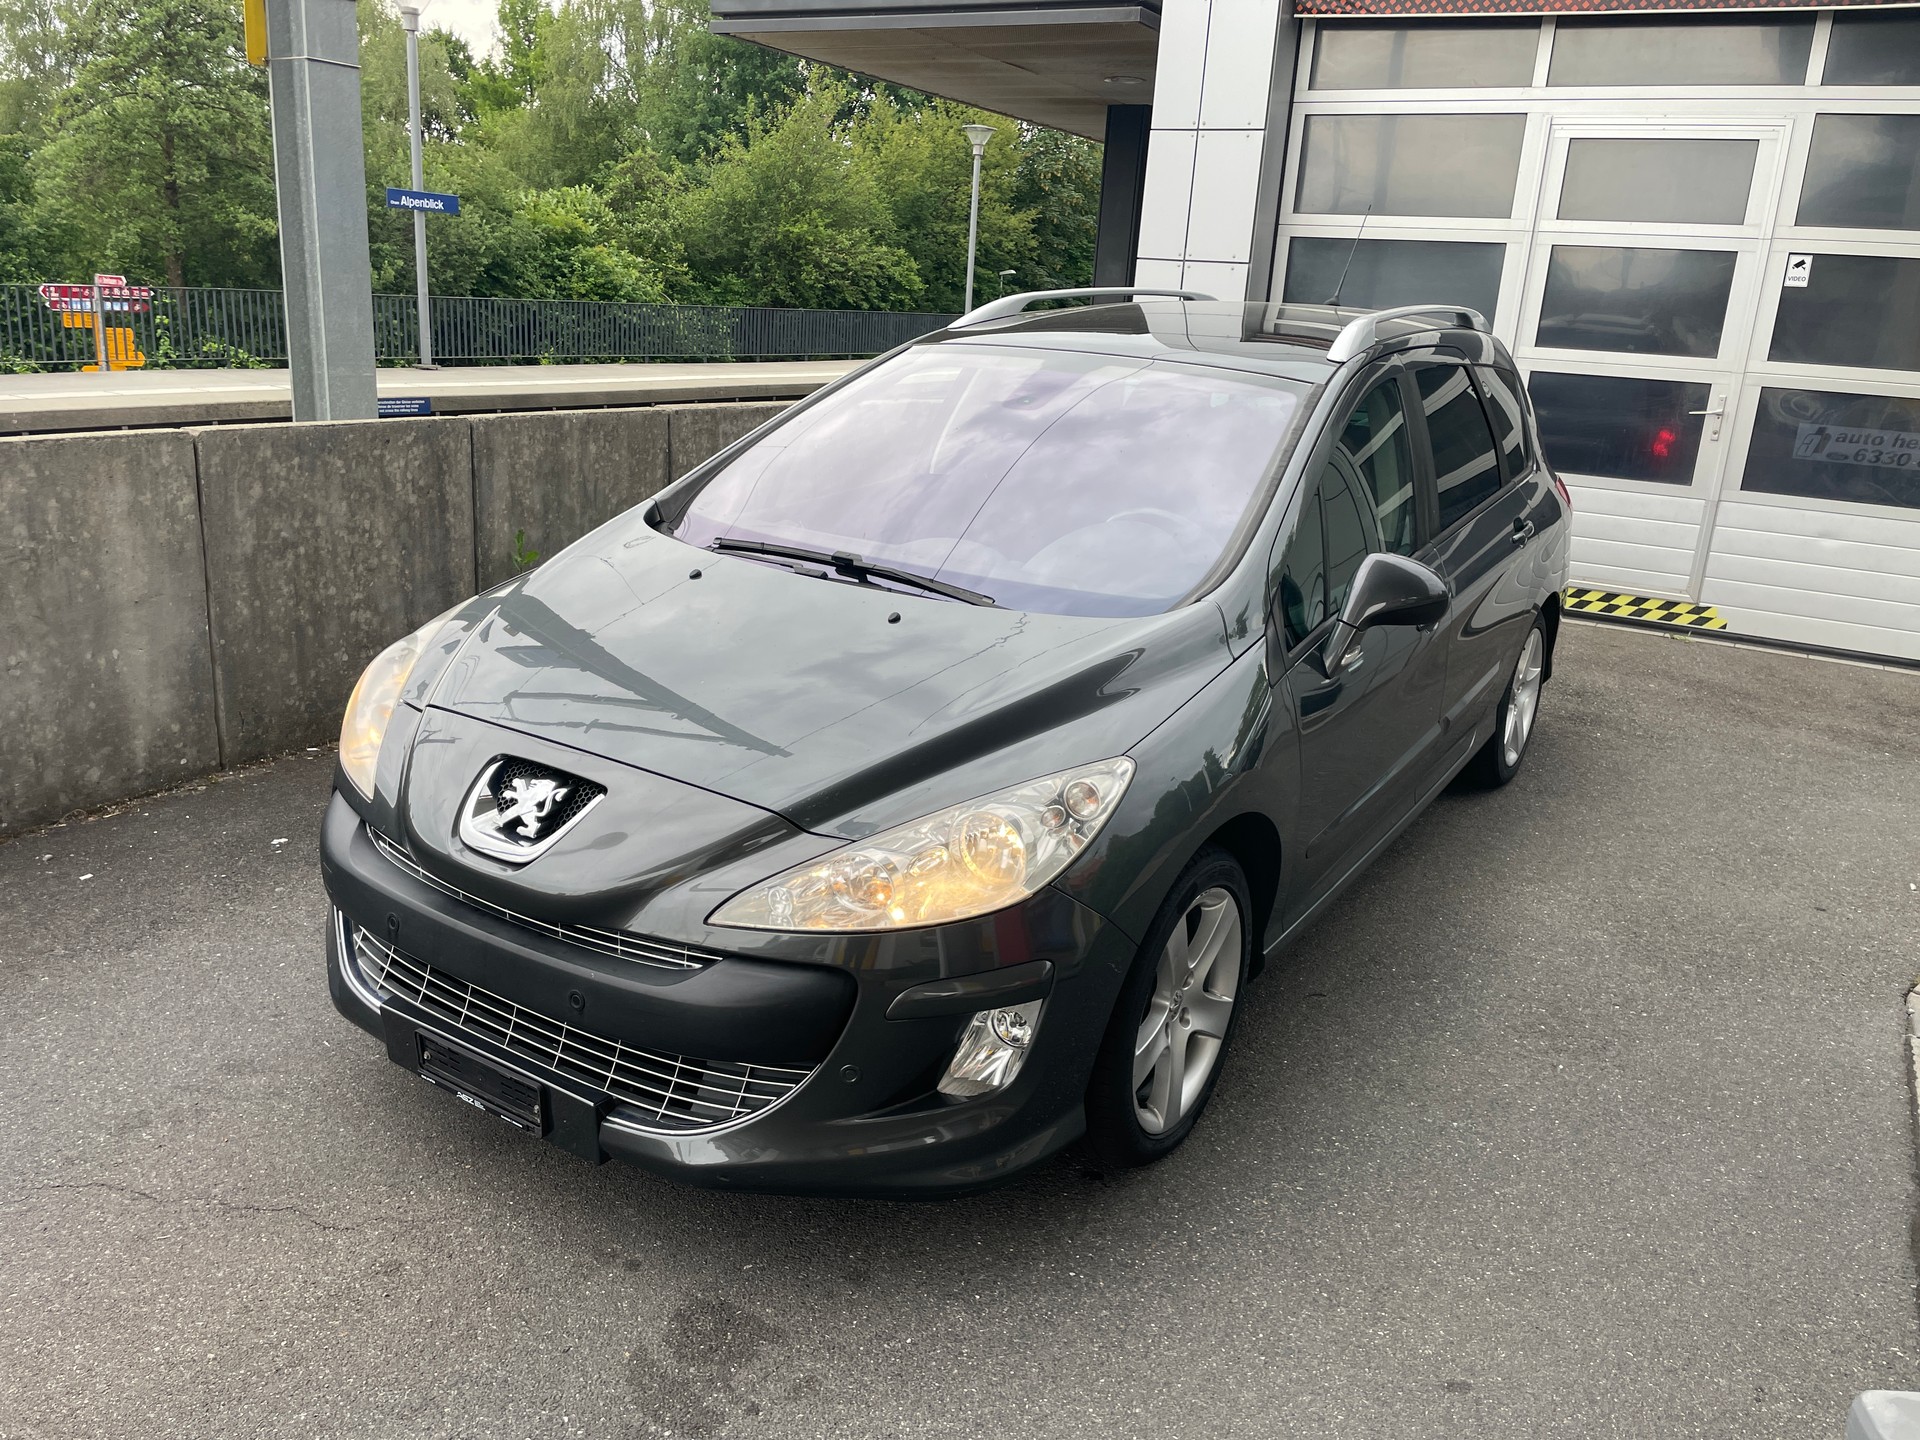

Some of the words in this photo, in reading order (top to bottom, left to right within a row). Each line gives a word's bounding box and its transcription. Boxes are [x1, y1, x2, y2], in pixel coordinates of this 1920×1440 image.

[400, 195, 444, 209] Alpenblick
[1835, 432, 1885, 446] auto
[1892, 433, 1920, 449] he
[1853, 448, 1912, 467] 6330
